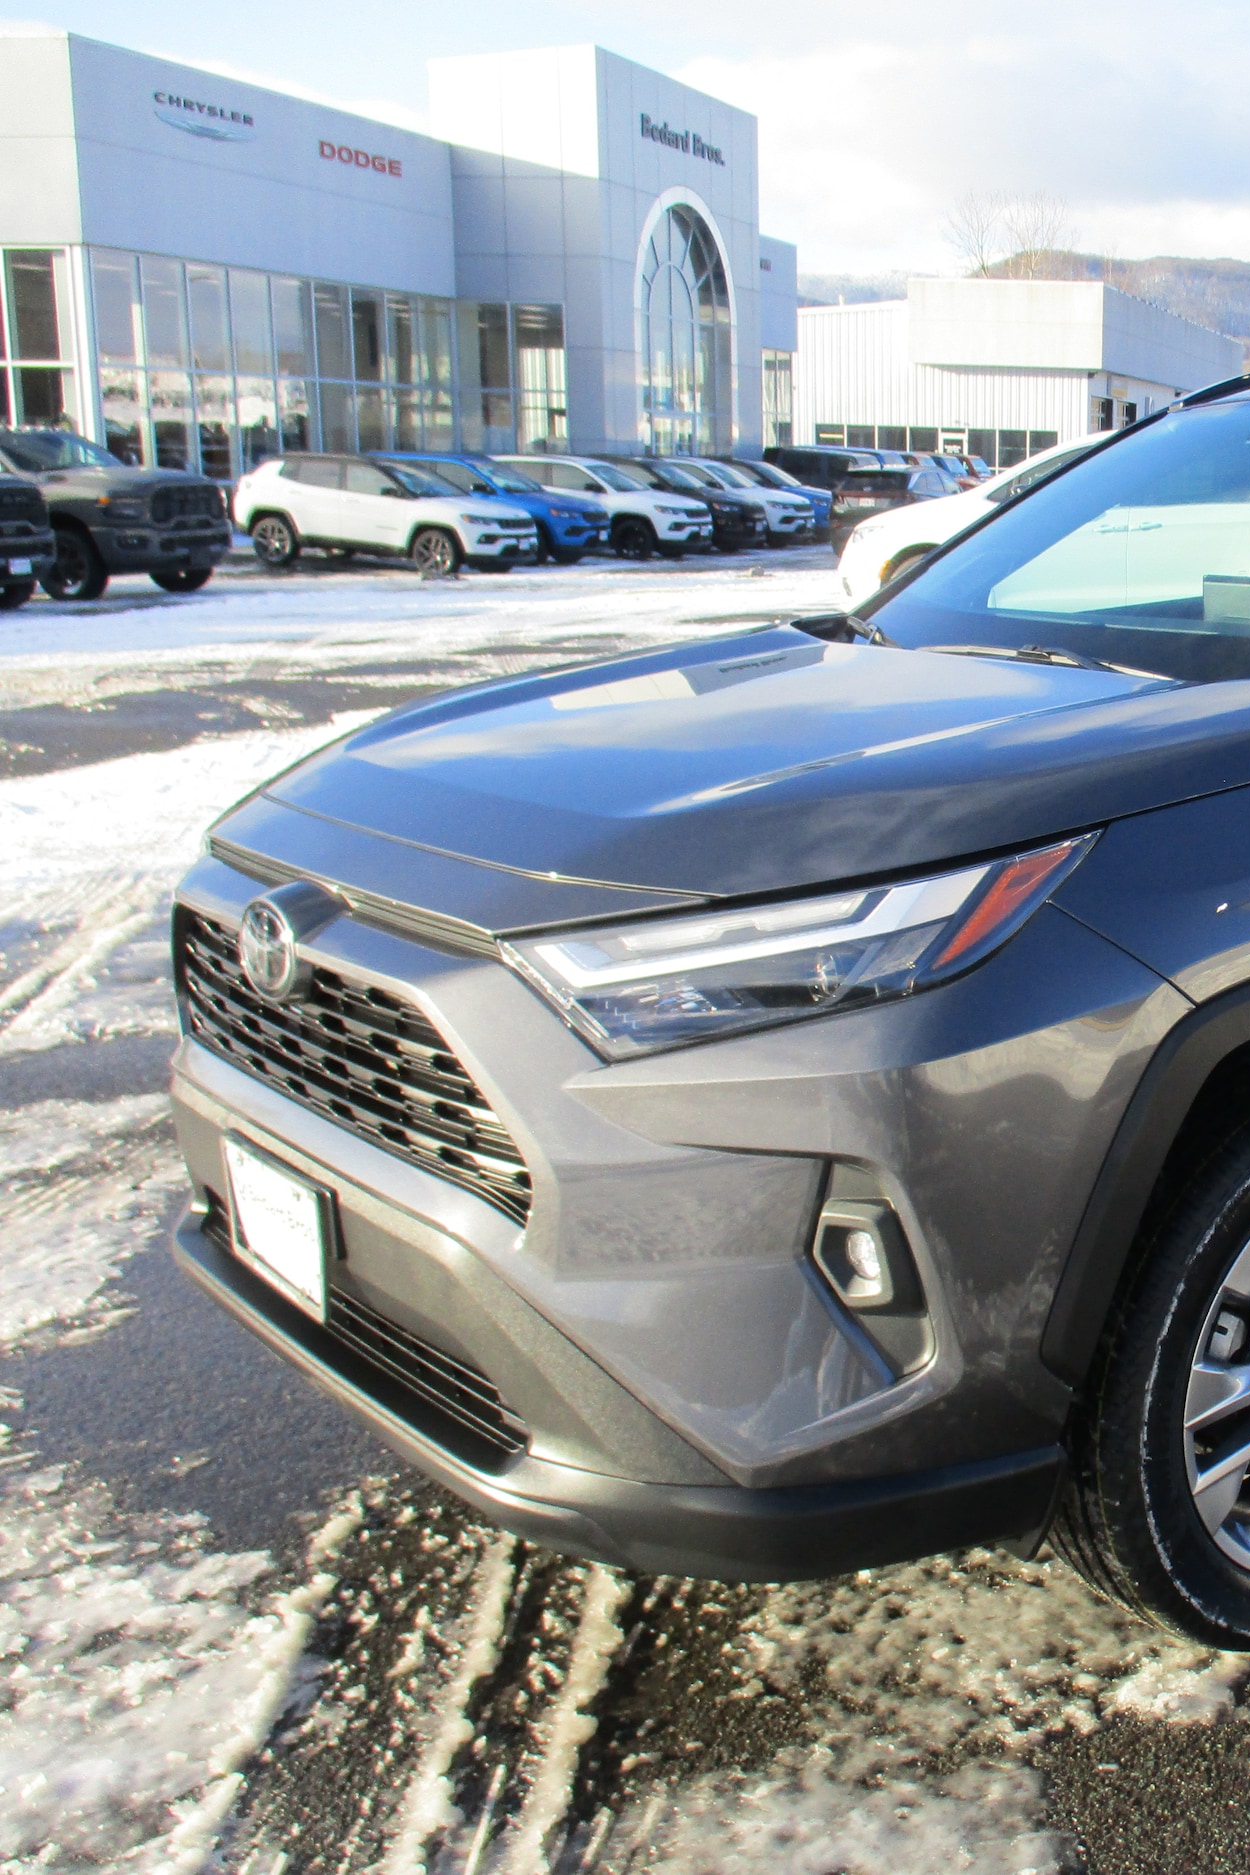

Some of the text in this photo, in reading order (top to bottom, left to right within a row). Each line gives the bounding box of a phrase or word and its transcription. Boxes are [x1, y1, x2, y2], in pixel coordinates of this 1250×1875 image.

[154, 93, 254, 126] CHRYSLER
[641, 113, 725, 166] Bedard Bros.
[319, 141, 402, 175] DODGE
